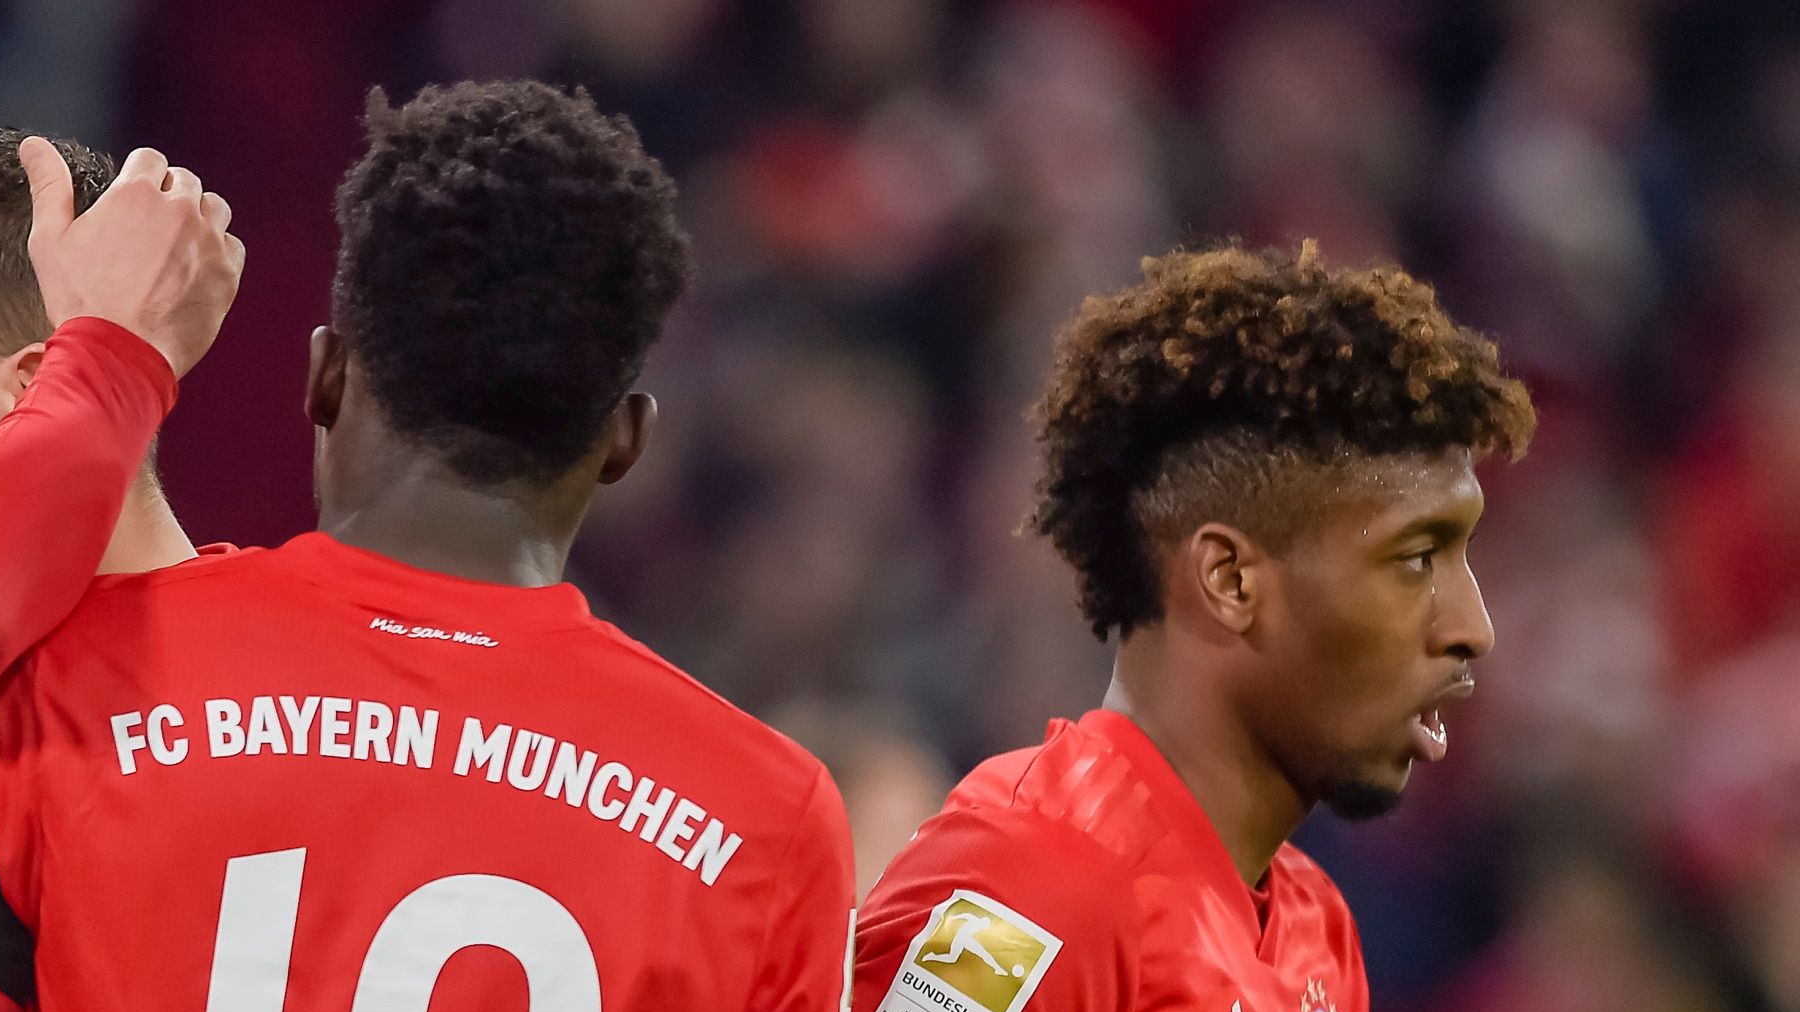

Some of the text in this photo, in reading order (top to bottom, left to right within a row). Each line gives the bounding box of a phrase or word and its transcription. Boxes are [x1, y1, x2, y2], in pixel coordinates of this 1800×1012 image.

[369, 617, 500, 648] Mia san mia
[110, 695, 744, 887] FC BAYERN MÜNCHEN
